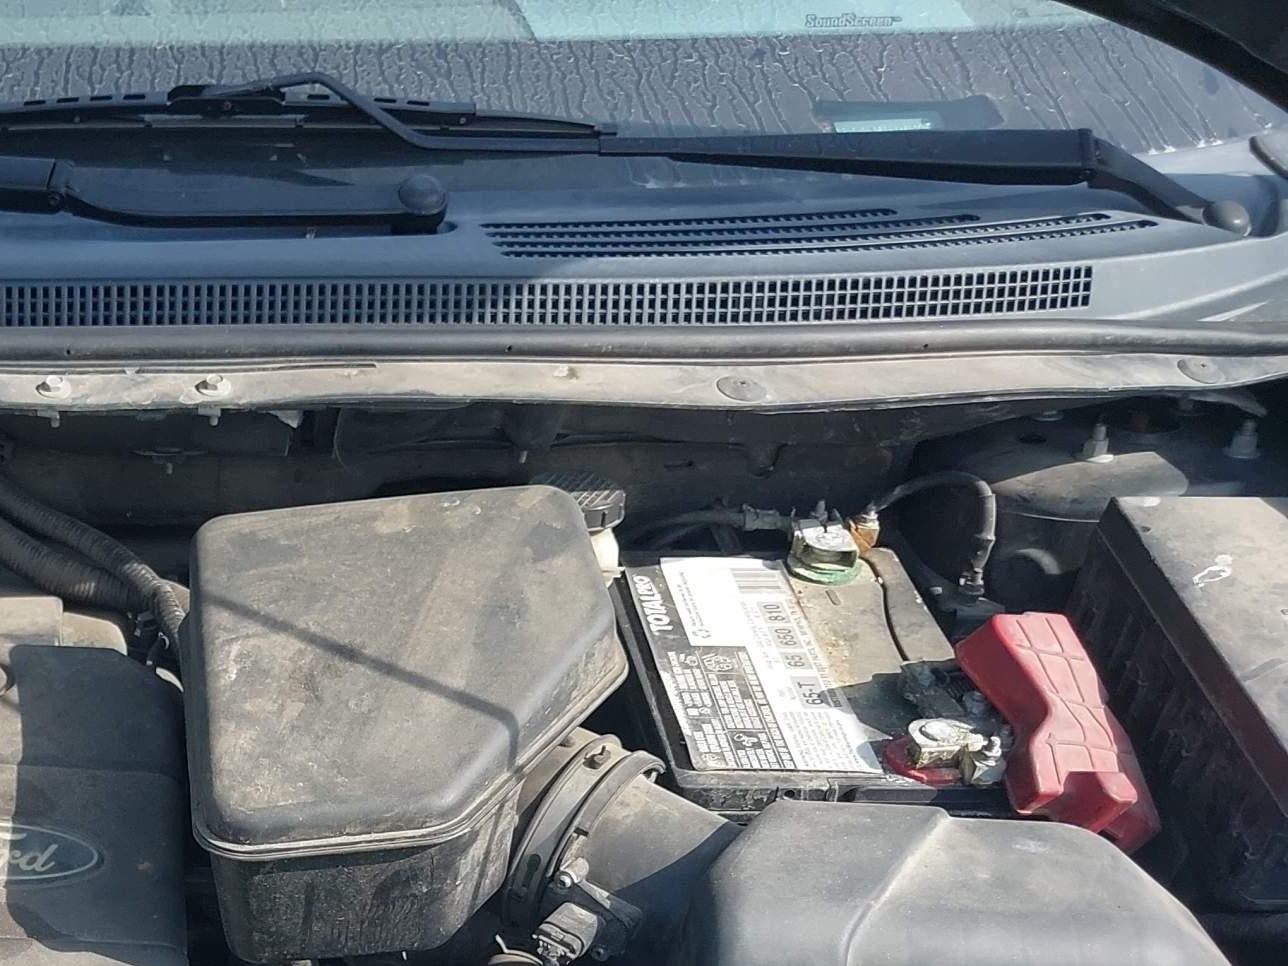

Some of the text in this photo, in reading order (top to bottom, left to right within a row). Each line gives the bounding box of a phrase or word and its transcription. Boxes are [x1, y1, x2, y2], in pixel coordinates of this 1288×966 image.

[764, 603, 786, 622] 810
[775, 628, 797, 646] 650
[787, 655, 804, 668] 65
[798, 681, 824, 705] 65-T
